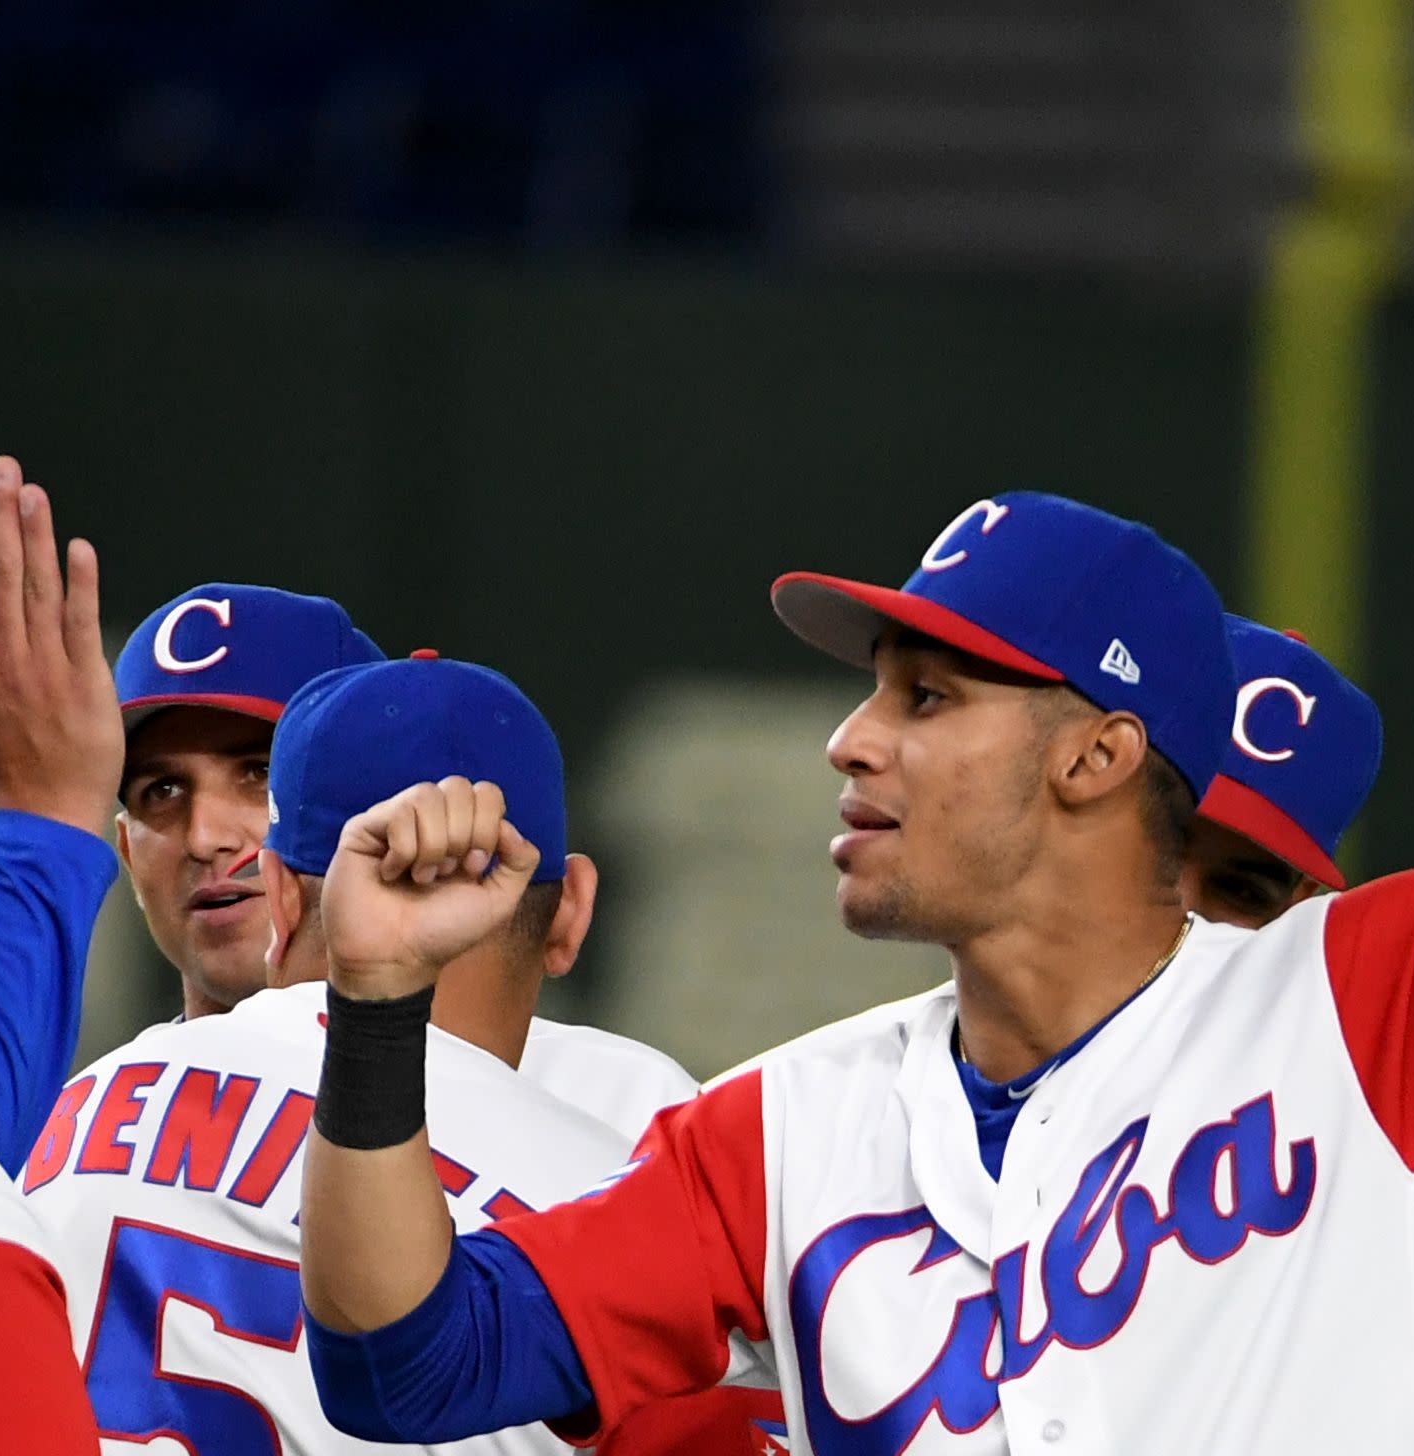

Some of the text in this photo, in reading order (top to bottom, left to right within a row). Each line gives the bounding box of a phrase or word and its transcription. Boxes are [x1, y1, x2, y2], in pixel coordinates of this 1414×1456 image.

[921, 498, 1008, 572] C
[153, 597, 231, 674] C
[1231, 676, 1317, 763] C
[22, 1061, 537, 1226] BENI
